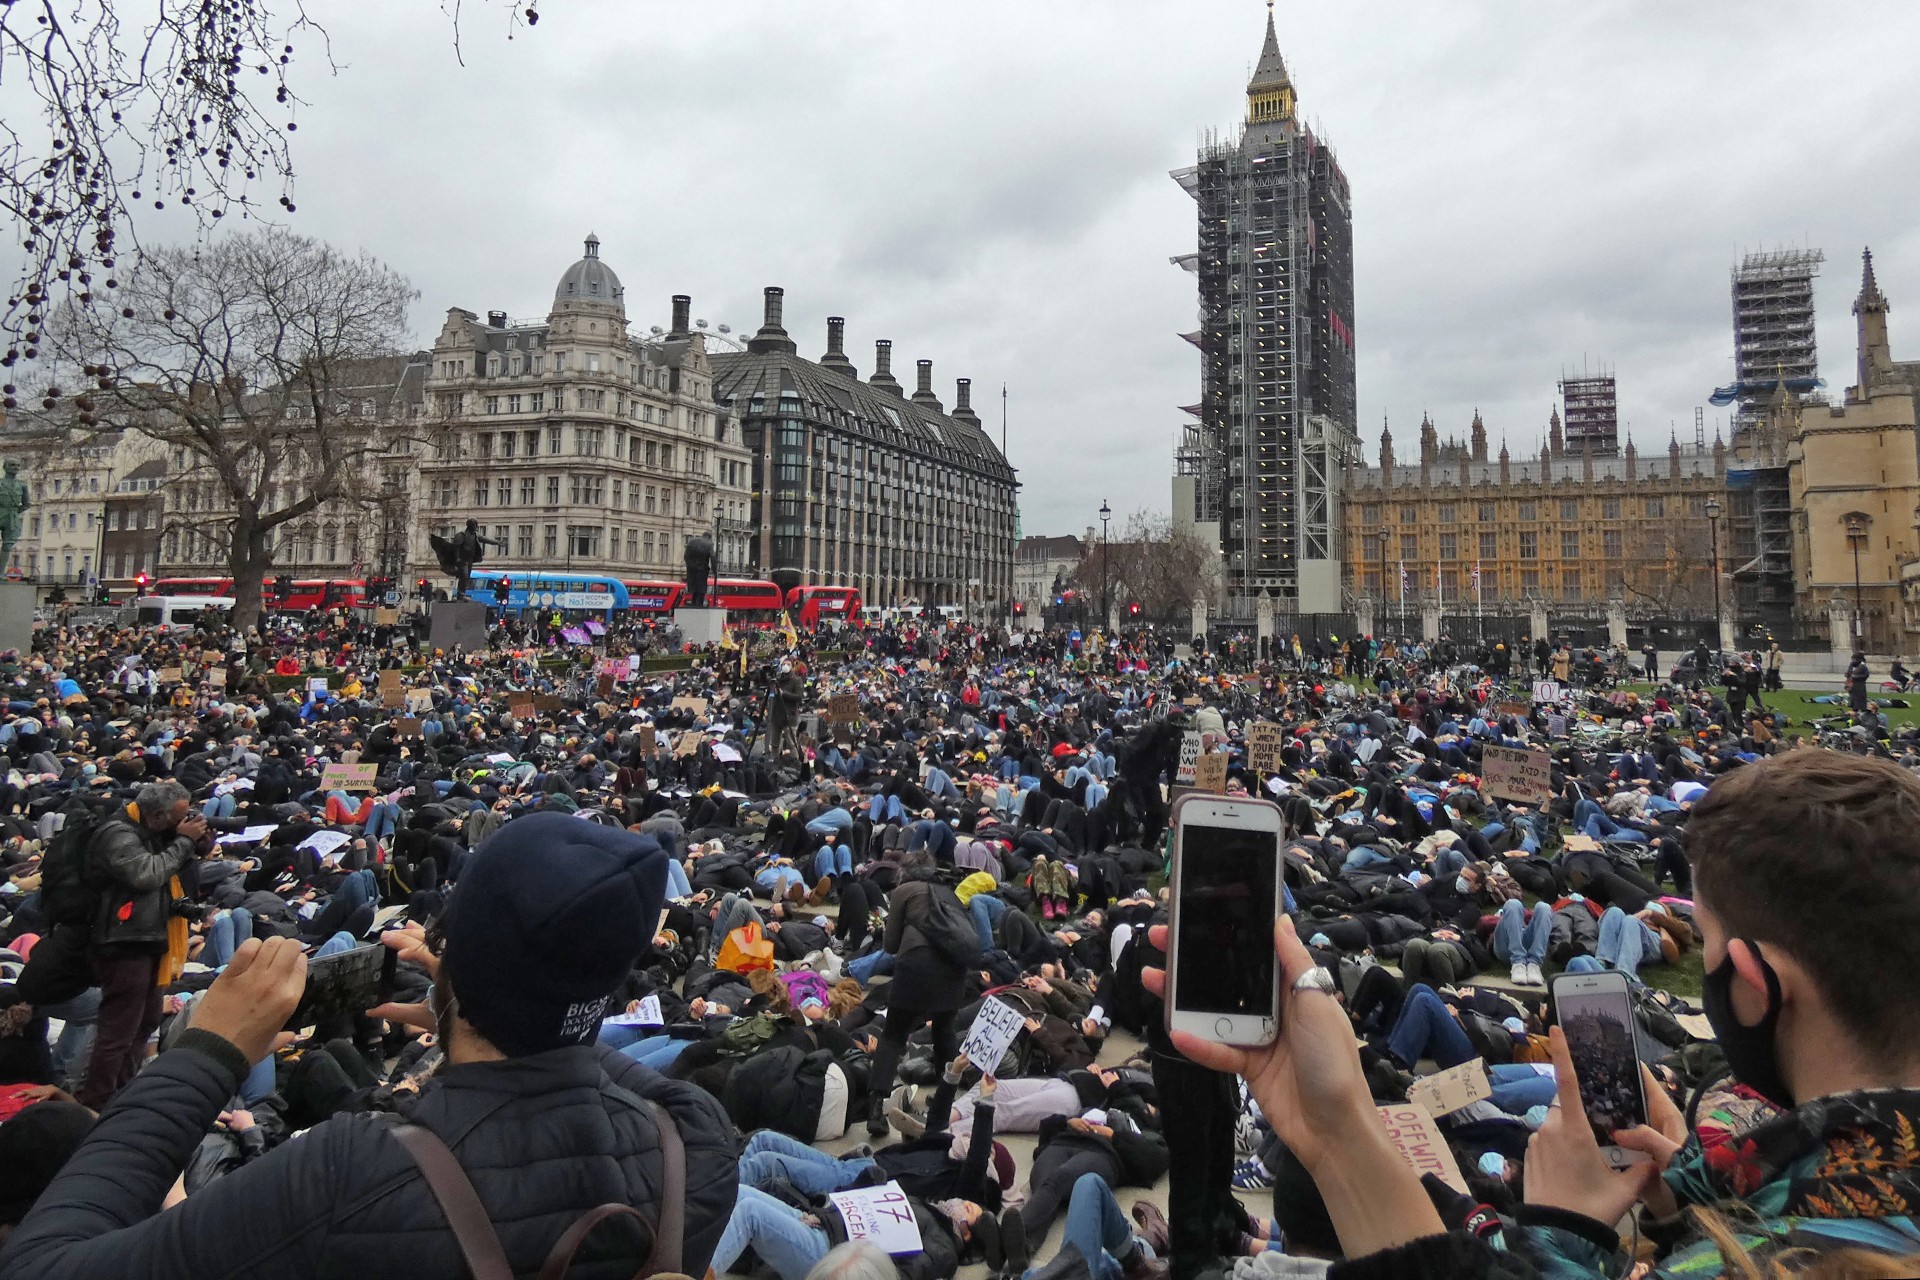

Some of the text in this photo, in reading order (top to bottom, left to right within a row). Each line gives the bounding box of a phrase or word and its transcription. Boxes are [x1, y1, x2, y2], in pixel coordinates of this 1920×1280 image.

[1252, 725, 1281, 735] TXT ME
[1181, 739, 1200, 747] WHO
[1255, 734, 1275, 742] WHEN
[1252, 744, 1280, 753] YOURE
[1253, 752, 1274, 760] HOME
[1179, 767, 1196, 775] TRUS
[1253, 761, 1274, 771] BABE
[567, 1000, 598, 1018] BIG
[980, 998, 1021, 1040] BELIEVE
[981, 1025, 993, 1043] ALL
[873, 1192, 914, 1224] 97
[837, 1196, 867, 1241] PERCEN
[857, 1195, 881, 1235] FUCKING
